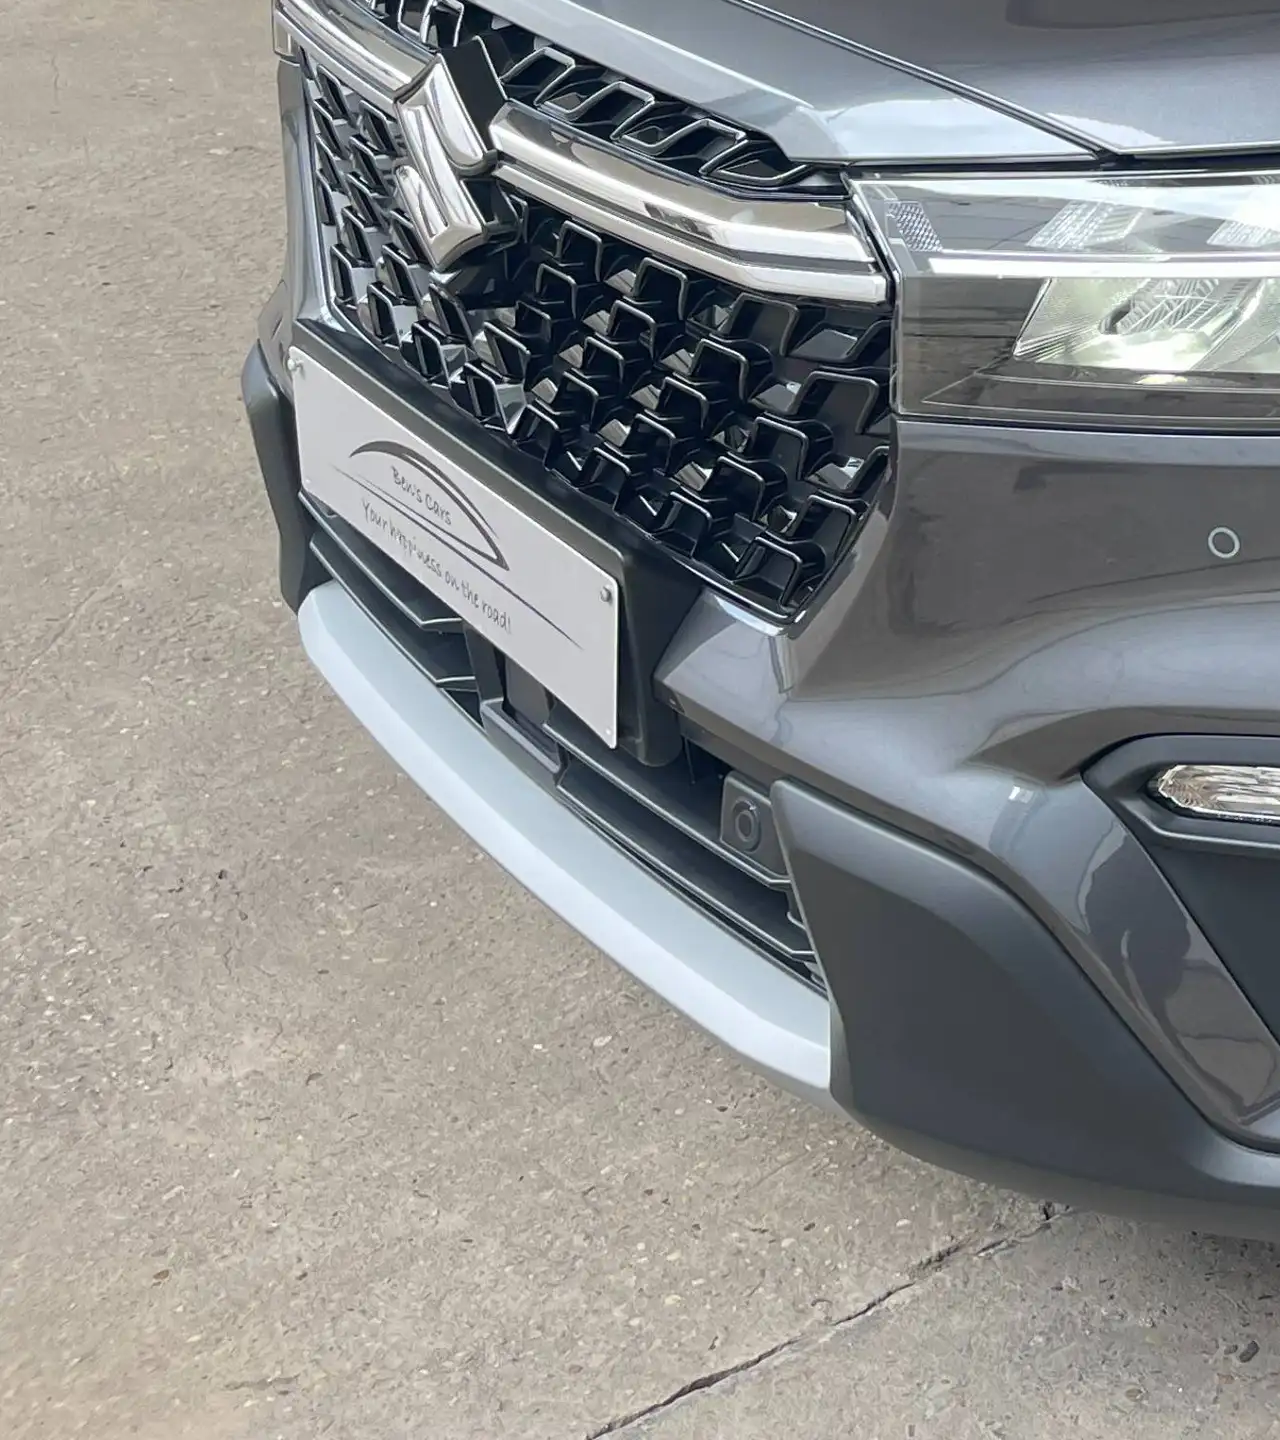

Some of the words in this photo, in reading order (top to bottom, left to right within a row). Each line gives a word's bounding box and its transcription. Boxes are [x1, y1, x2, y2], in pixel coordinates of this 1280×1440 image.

[425, 494, 452, 525] Cars
[362, 497, 388, 530] Your
[444, 570, 460, 591] on
[461, 579, 480, 608] the
